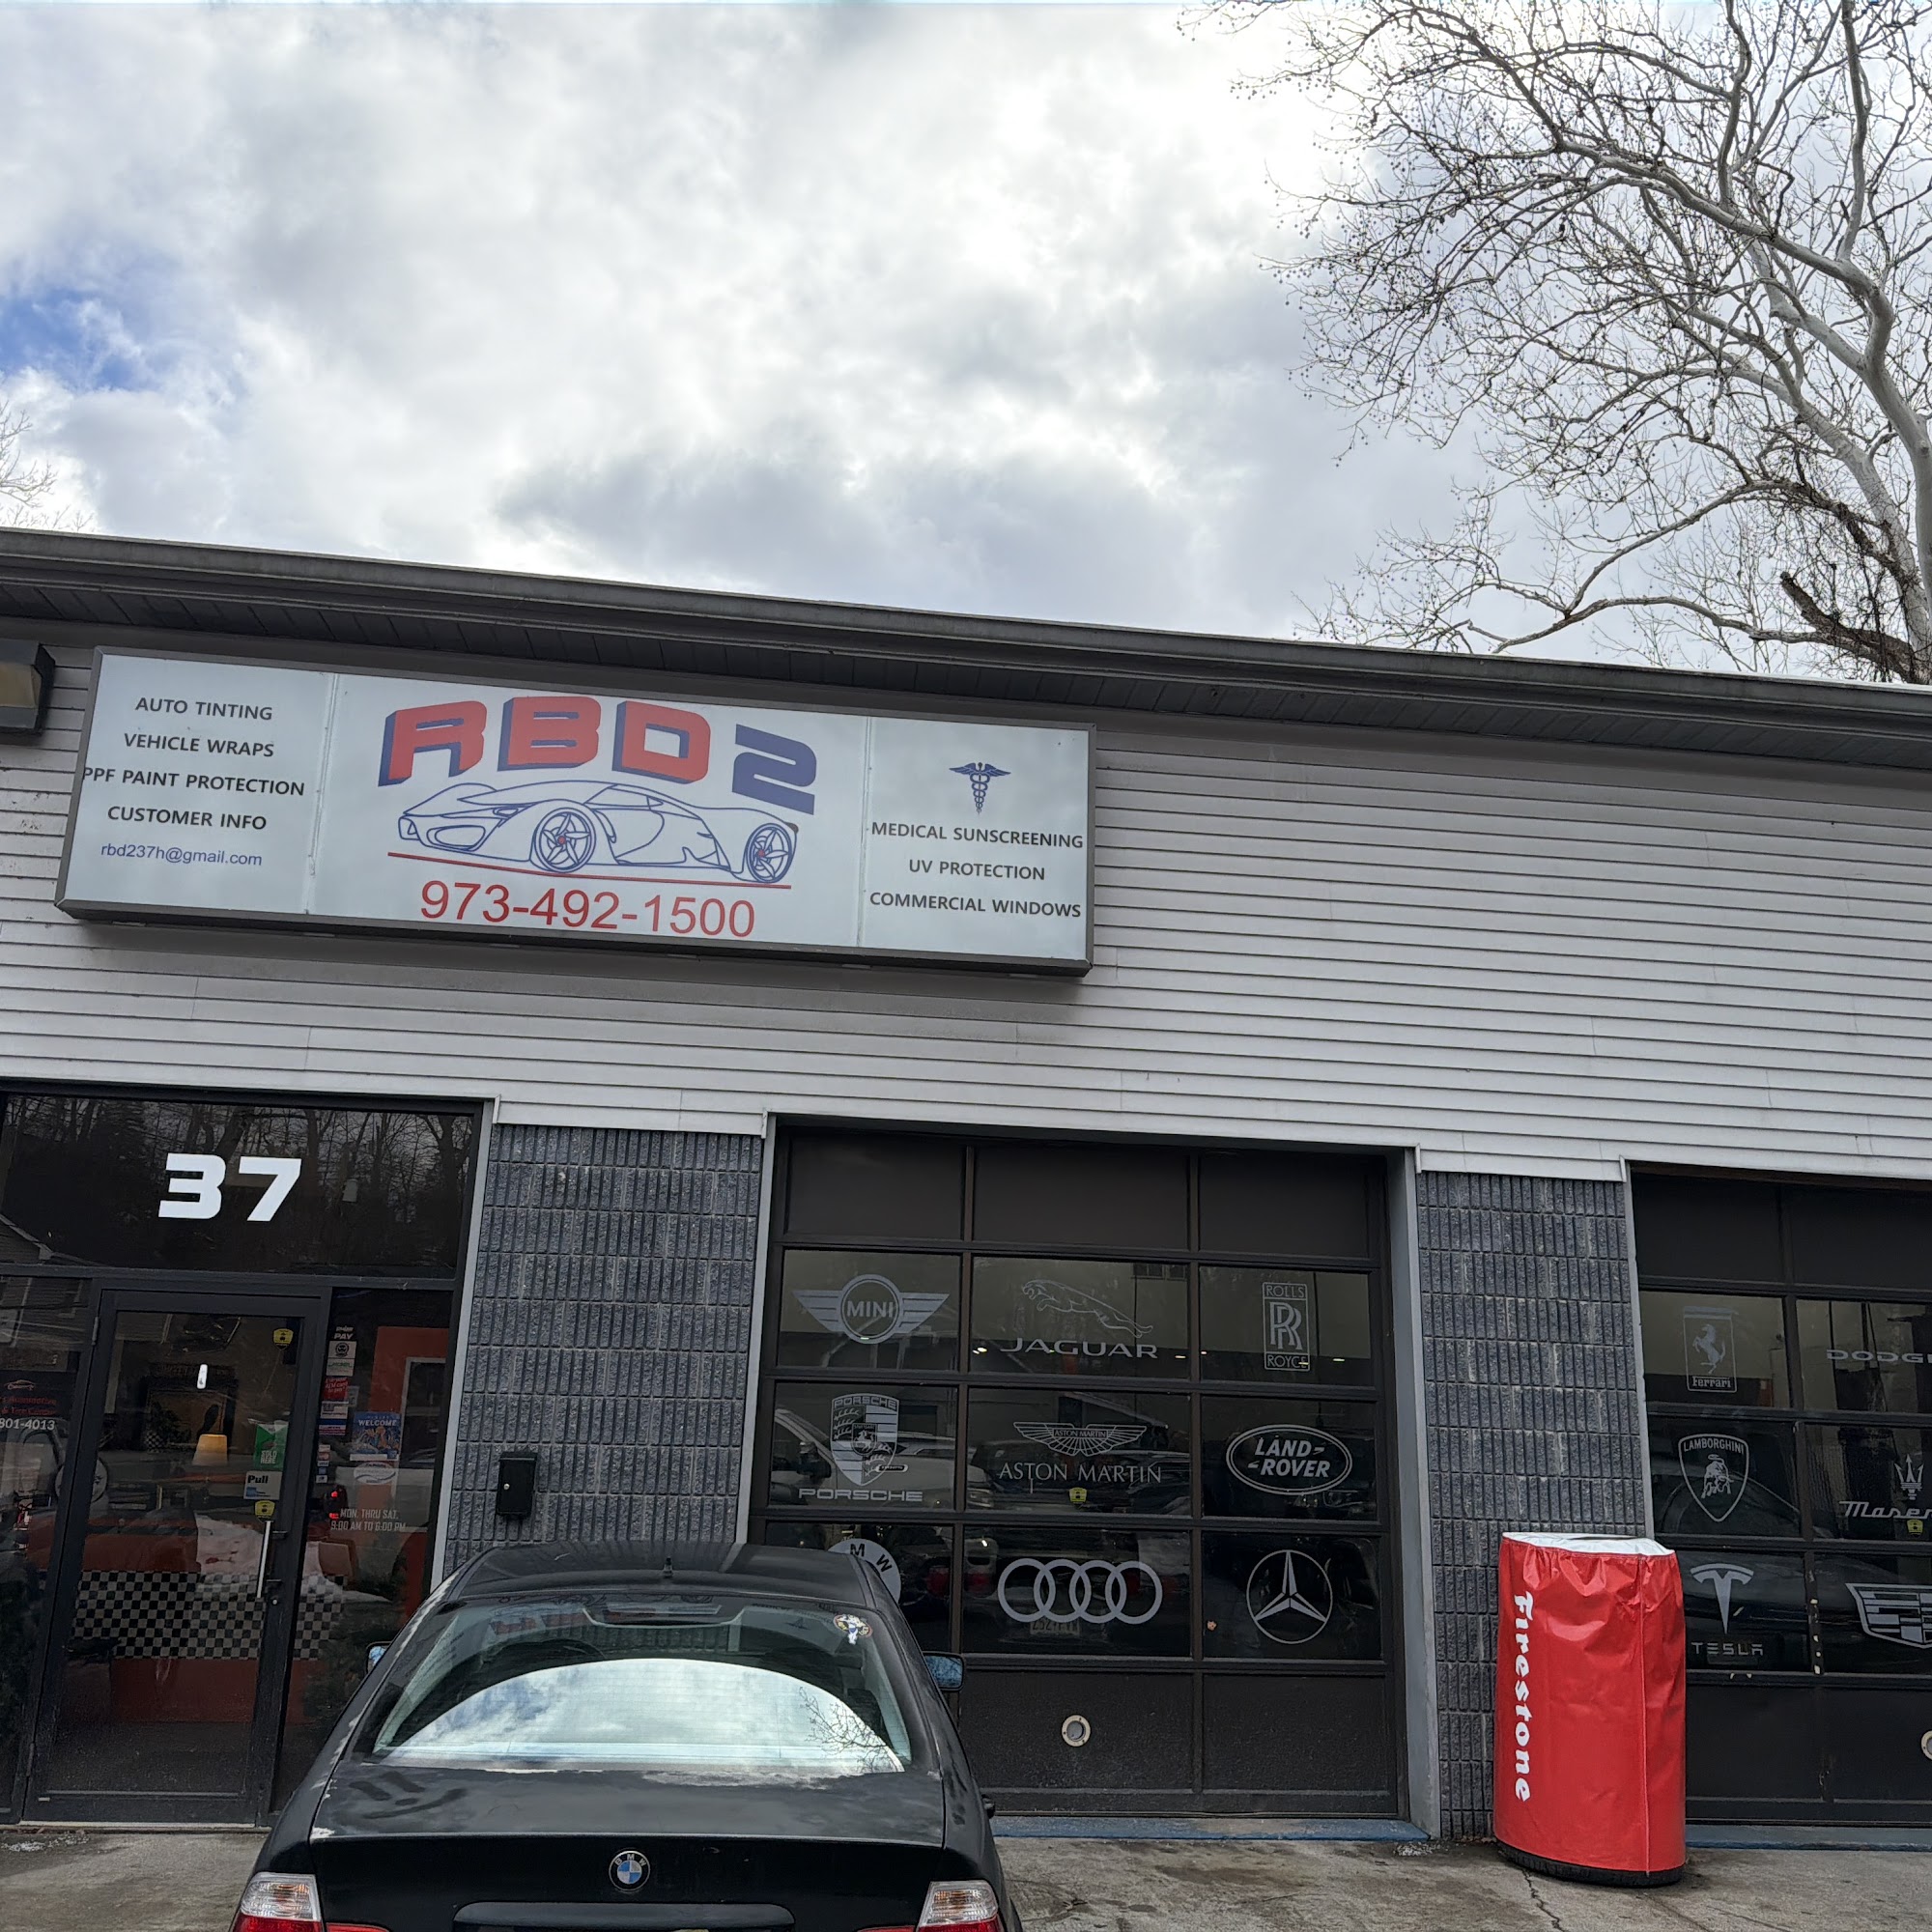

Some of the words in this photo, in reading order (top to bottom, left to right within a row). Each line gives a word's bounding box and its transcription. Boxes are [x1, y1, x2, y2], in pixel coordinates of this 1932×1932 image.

[135, 697, 188, 714] AUTO
[195, 701, 273, 721] TINTING
[124, 733, 200, 752] VEHICLE
[207, 739, 274, 757] WRAPS
[378, 696, 711, 786] RBD
[732, 724, 817, 815] 2
[83, 767, 116, 782] PPF
[122, 770, 180, 787] PAINT
[185, 774, 305, 796] PROTECTION
[107, 806, 213, 827] CUSTOMER
[220, 813, 267, 830] INFO
[871, 822, 948, 839] MEDICAL
[953, 827, 1084, 848] SUNSCREENING
[100, 843, 263, 867] rbd237h@gmail.com
[909, 859, 933, 873] UV
[939, 861, 1045, 880] PROTECTION
[420, 880, 755, 938] 973-492-1500
[869, 892, 986, 913] COMMERCIAL
[992, 899, 1081, 918] WINDOWS
[158, 1152, 301, 1221] 37
[1266, 1285, 1305, 1298] ROLLS
[847, 1300, 894, 1318] MINI
[1000, 1337, 1158, 1358] JAGUAR
[1826, 1350, 1932, 1364] DODG
[1266, 1354, 1308, 1369] ROYCE
[1691, 1376, 1732, 1388] Ferrari
[834, 1396, 897, 1409] PORSCHE
[1054, 1429, 1078, 1437] ASTON
[1079, 1430, 1108, 1438] MARTIN
[1683, 1437, 1745, 1455] LAMBORGHINI
[247, 1475, 270, 1484] Pull
[999, 1463, 1067, 1481] ASTON
[1077, 1464, 1161, 1483] MARTIN
[798, 1488, 923, 1502] PORSCHE
[361, 1509, 381, 1519] THRU
[350, 1520, 361, 1531] AM
[364, 1520, 374, 1531] TO
[394, 1521, 407, 1532] PM
[1690, 1642, 1764, 1656] TESLA
[1514, 1590, 1534, 1803] Firestone
[614, 1853, 647, 1866] BMW
